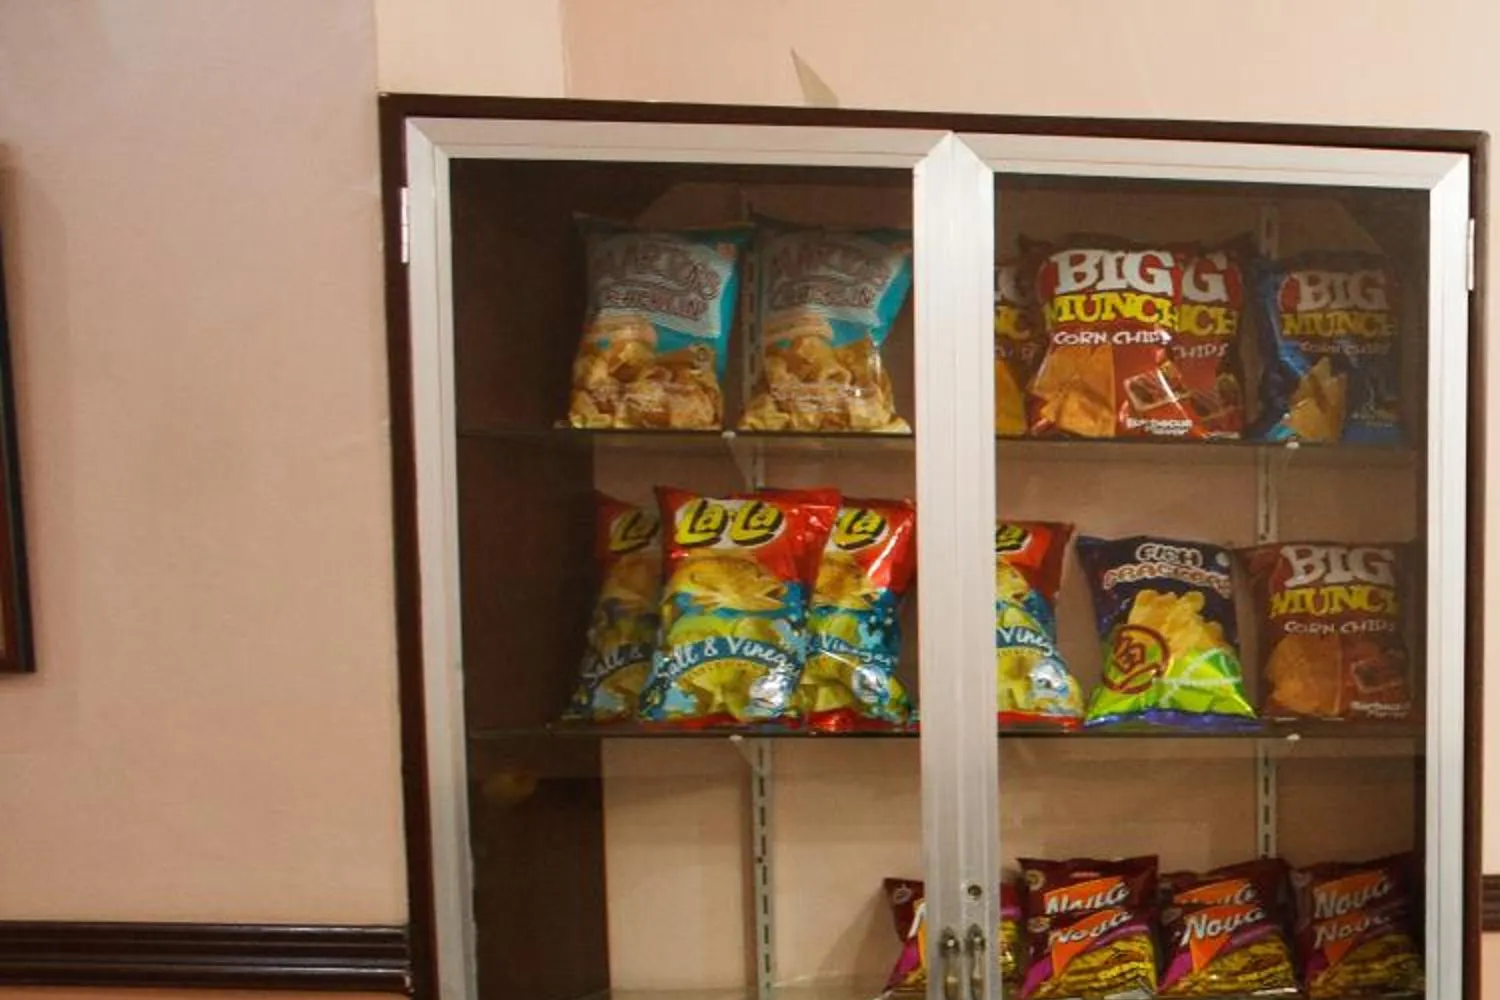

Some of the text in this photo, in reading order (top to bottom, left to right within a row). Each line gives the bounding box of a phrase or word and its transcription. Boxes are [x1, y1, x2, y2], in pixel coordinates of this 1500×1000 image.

[1050, 250, 1174, 297] BIG
[1297, 269, 1391, 312] BIG
[1053, 331, 1106, 346] CORN
[1279, 545, 1396, 588] BIG
[1284, 621, 1335, 635] CORN
